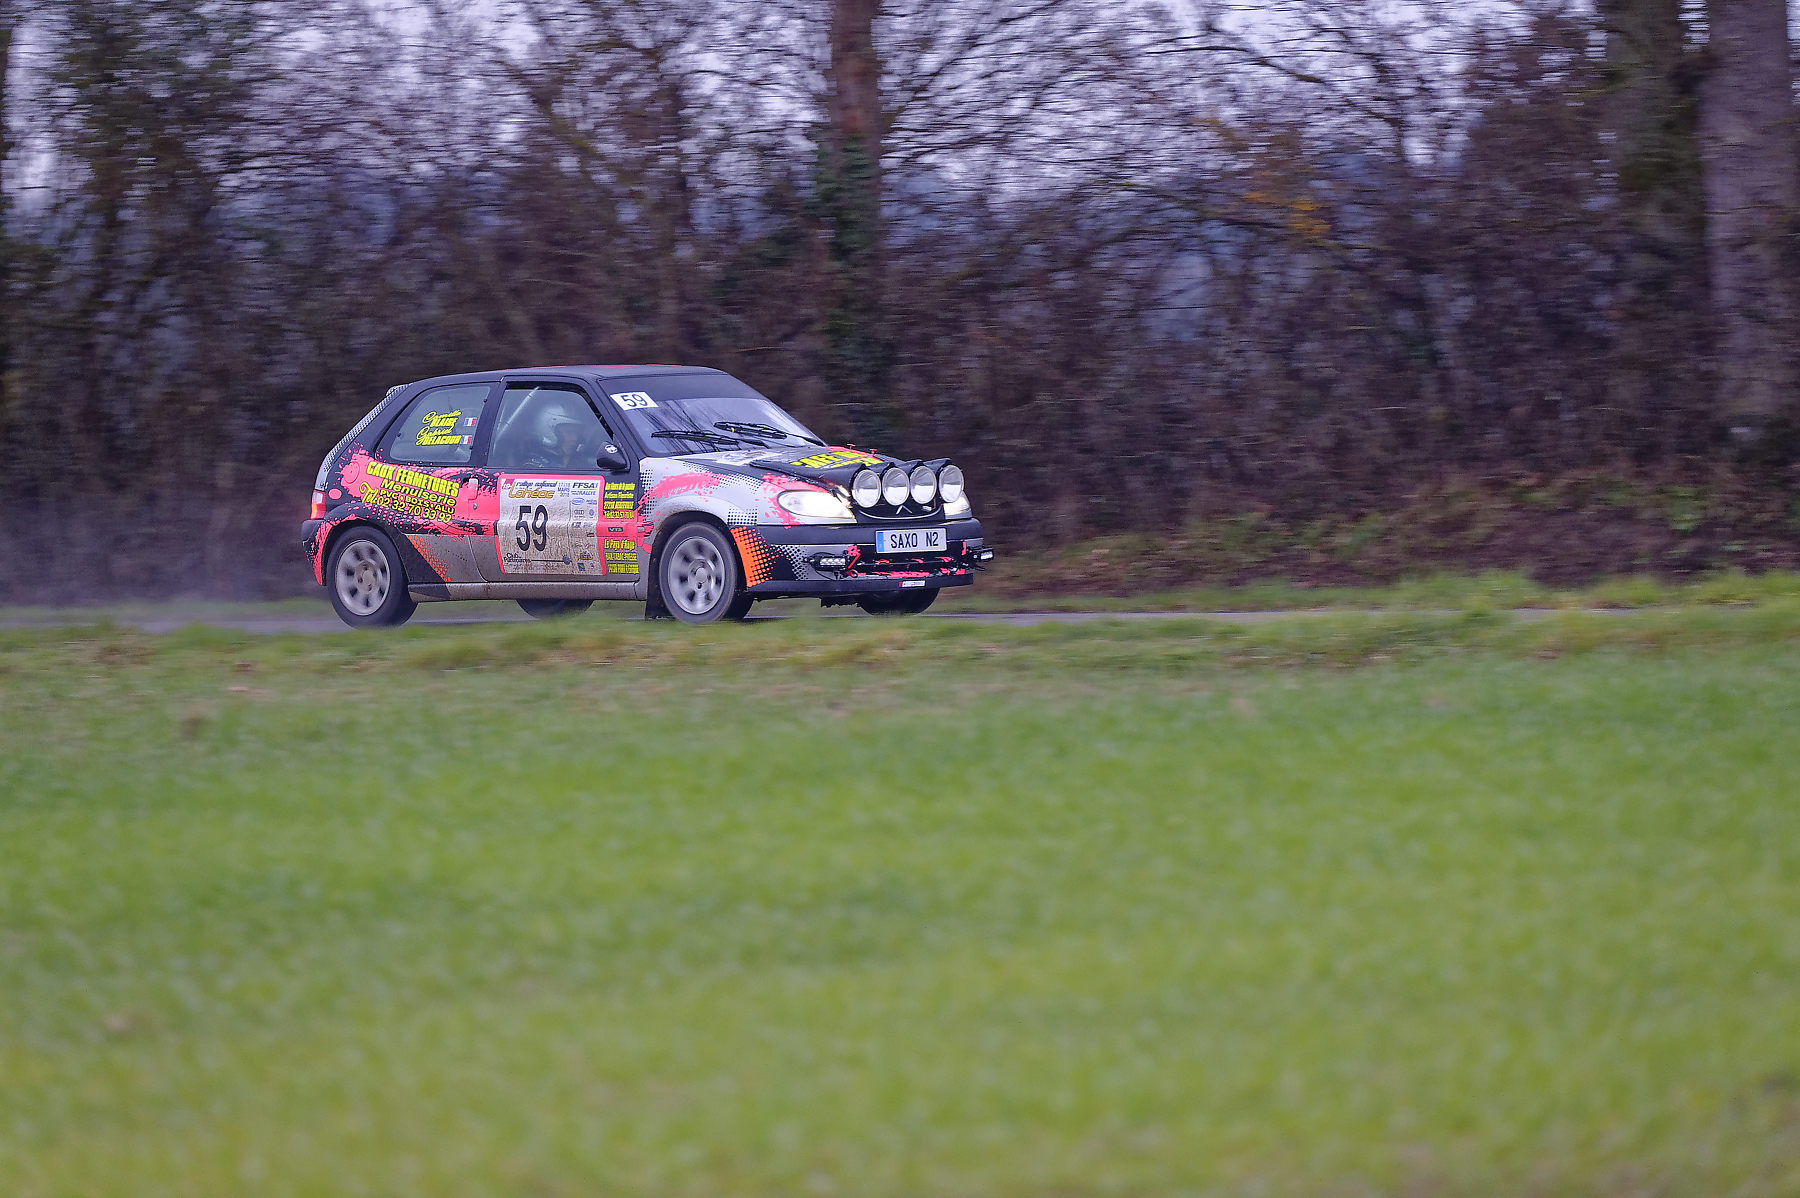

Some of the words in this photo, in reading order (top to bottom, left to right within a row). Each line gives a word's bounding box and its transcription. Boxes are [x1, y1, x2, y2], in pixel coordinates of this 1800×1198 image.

[620, 393, 648, 408] 59
[366, 461, 395, 480] CAUX
[395, 467, 460, 497] FERMETURES
[380, 479, 457, 506] Menuiserie
[377, 496, 391, 507] 02
[391, 499, 406, 512] 32
[408, 504, 421, 516] 70
[422, 508, 437, 520] 33
[437, 511, 452, 523] 93
[380, 489, 399, 499] PVC
[405, 495, 430, 508] BOIS
[435, 504, 455, 514] ALU
[516, 505, 548, 551] 59
[890, 532, 918, 548] SAXO
[926, 531, 939, 547] N2
